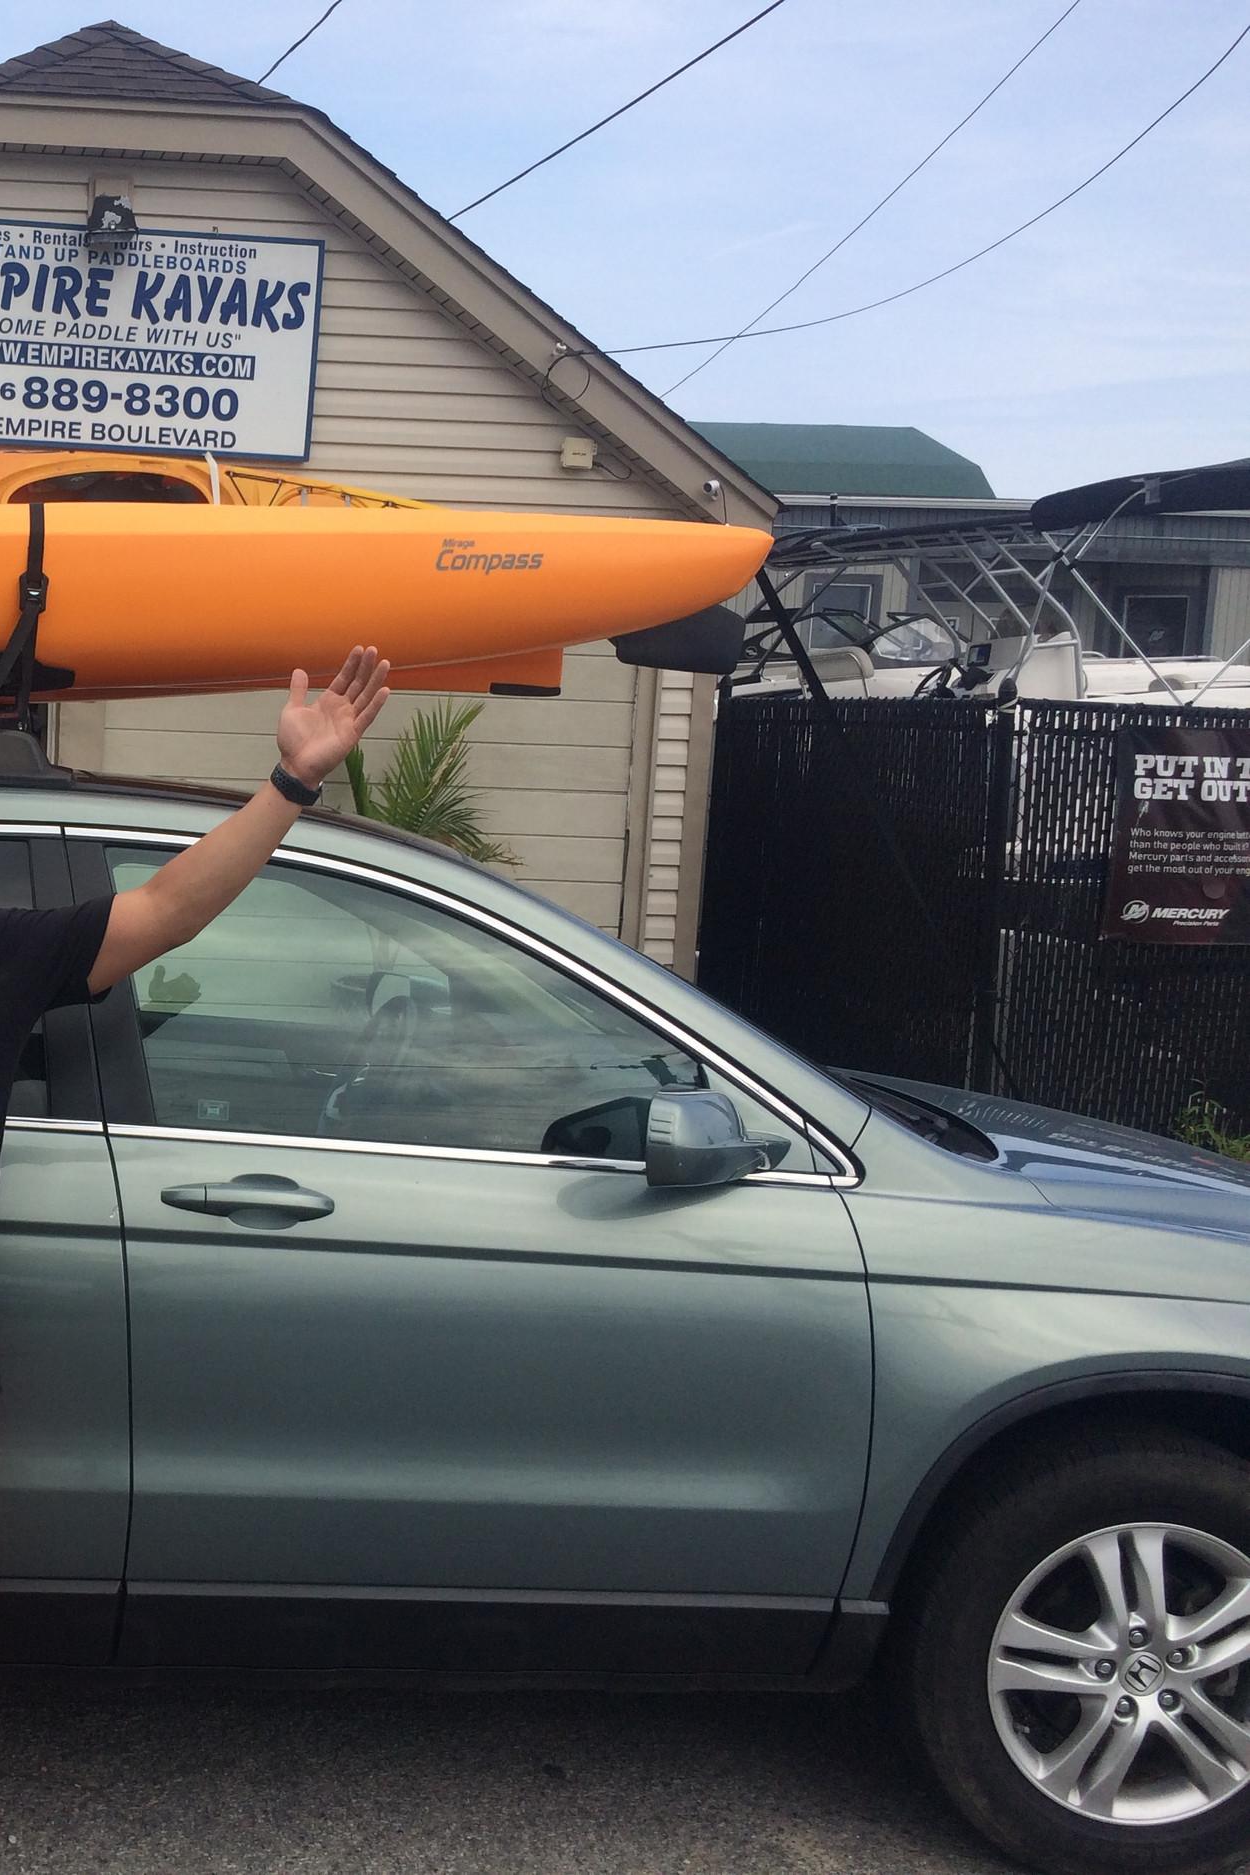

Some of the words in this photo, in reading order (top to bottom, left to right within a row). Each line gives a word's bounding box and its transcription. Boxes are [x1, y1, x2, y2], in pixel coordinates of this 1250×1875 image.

[33, 230, 90, 247] Rentals
[174, 240, 257, 259] Instruction
[54, 247, 79, 262] UP
[88, 249, 247, 275] PADDLEBOARDS
[131, 271, 311, 334] KAYAKS
[54, 322, 137, 342] PADDLE
[147, 327, 198, 346] WITH
[206, 332, 241, 348] US"
[22, 376, 239, 421] 889-8300
[91, 422, 237, 449] BOULEVARD
[436, 550, 544, 575] Compass
[1134, 754, 1198, 778] PUT
[1203, 756, 1230, 779] IN
[1134, 778, 1195, 800] GET
[1201, 781, 1250, 803] OUT
[1130, 840, 1151, 848] than
[1154, 841, 1167, 849] the
[1170, 842, 1200, 852] people
[1203, 842, 1220, 850] who
[1131, 828, 1151, 838] Who
[1154, 829, 1183, 838] knows
[1186, 831, 1204, 841] your
[1208, 831, 1236, 841] engine
[1128, 865, 1143, 874] get
[1146, 864, 1160, 872] the
[1163, 865, 1186, 873] most
[1188, 866, 1203, 874] out
[1215, 868, 1233, 876] your
[1129, 852, 1167, 864] Mercury
[1170, 854, 1193, 864] parts
[1196, 854, 1212, 862] and
[1151, 908, 1230, 919] MERCURY
